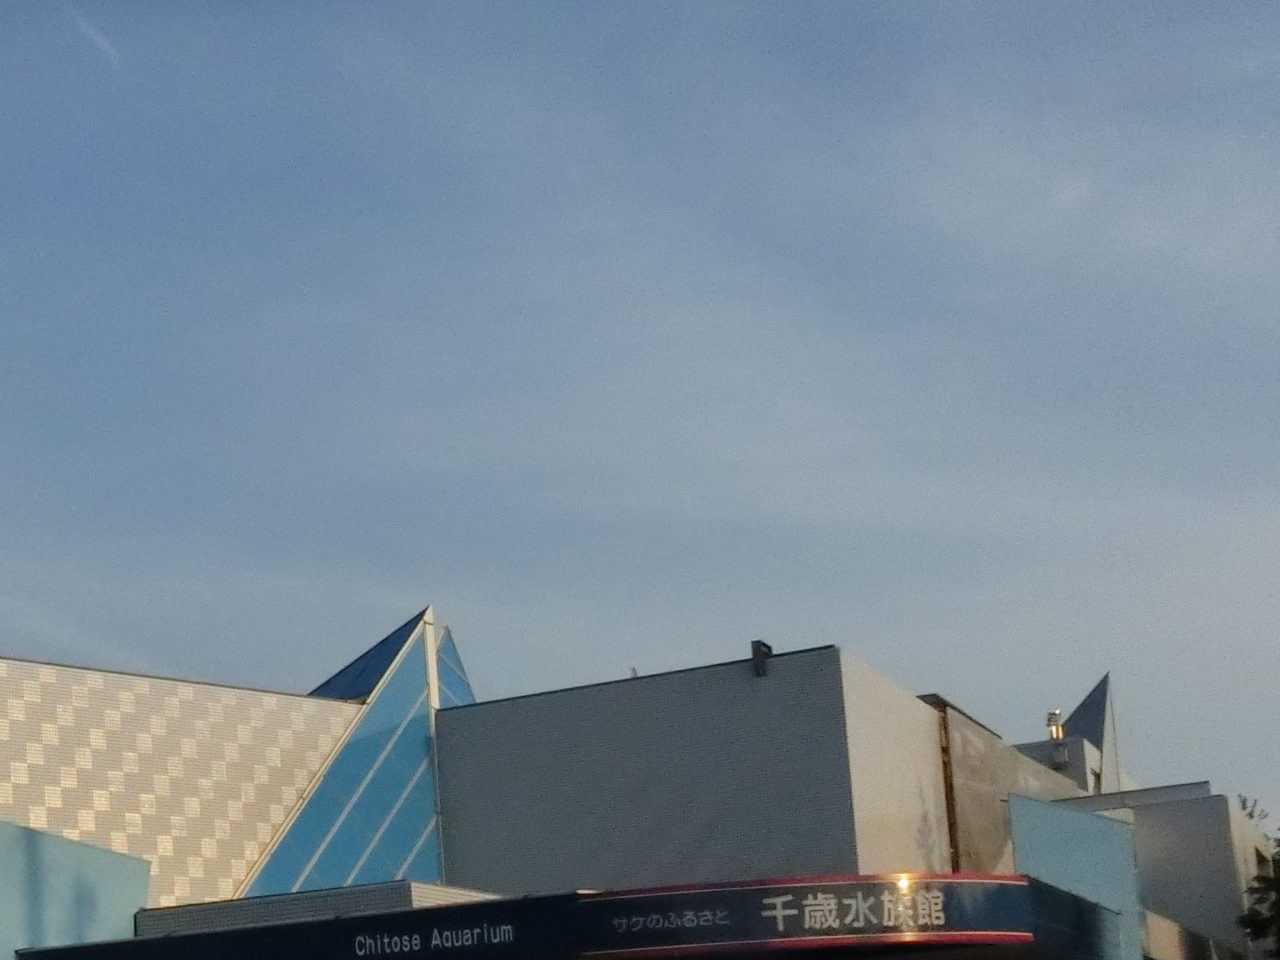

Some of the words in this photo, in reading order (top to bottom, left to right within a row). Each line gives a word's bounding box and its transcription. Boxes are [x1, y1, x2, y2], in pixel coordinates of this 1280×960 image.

[612, 910, 731, 932] サケのふるさと
[760, 891, 946, 932] 千歳水族館
[355, 934, 420, 956] Chitose
[431, 923, 514, 949] Aquarium
